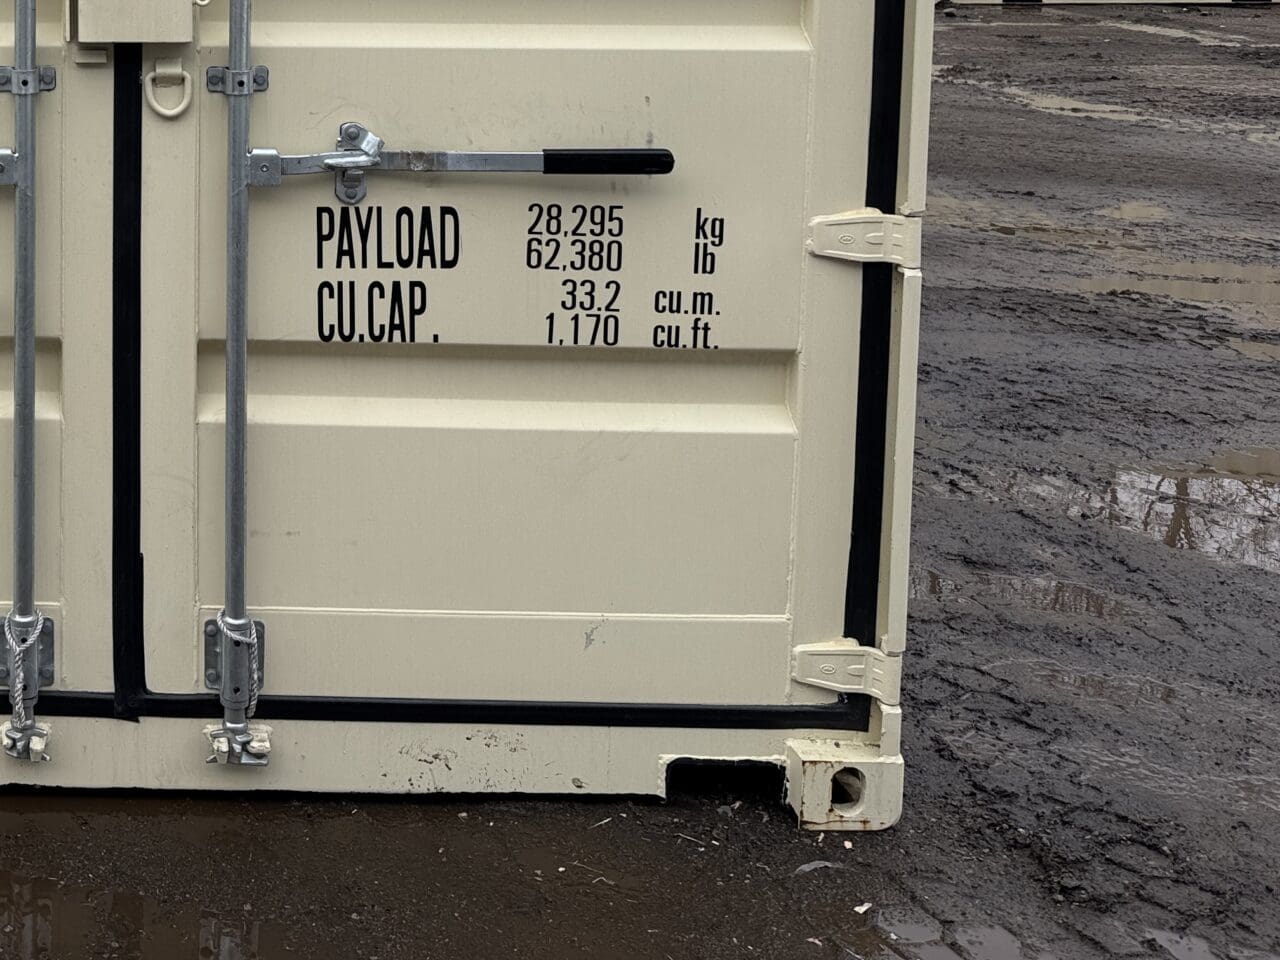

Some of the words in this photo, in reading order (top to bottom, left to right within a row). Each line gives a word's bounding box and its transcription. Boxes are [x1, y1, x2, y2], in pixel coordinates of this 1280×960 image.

[317, 206, 460, 270] PAYLOAD
[527, 203, 624, 238] 28,295
[695, 207, 725, 248] kg
[525, 238, 623, 272] 62,380
[693, 242, 716, 275] lb
[561, 279, 621, 313] 33.2
[654, 289, 721, 316] cu.m.
[545, 313, 620, 347] 1,170
[652, 318, 719, 350] cu.ft.
